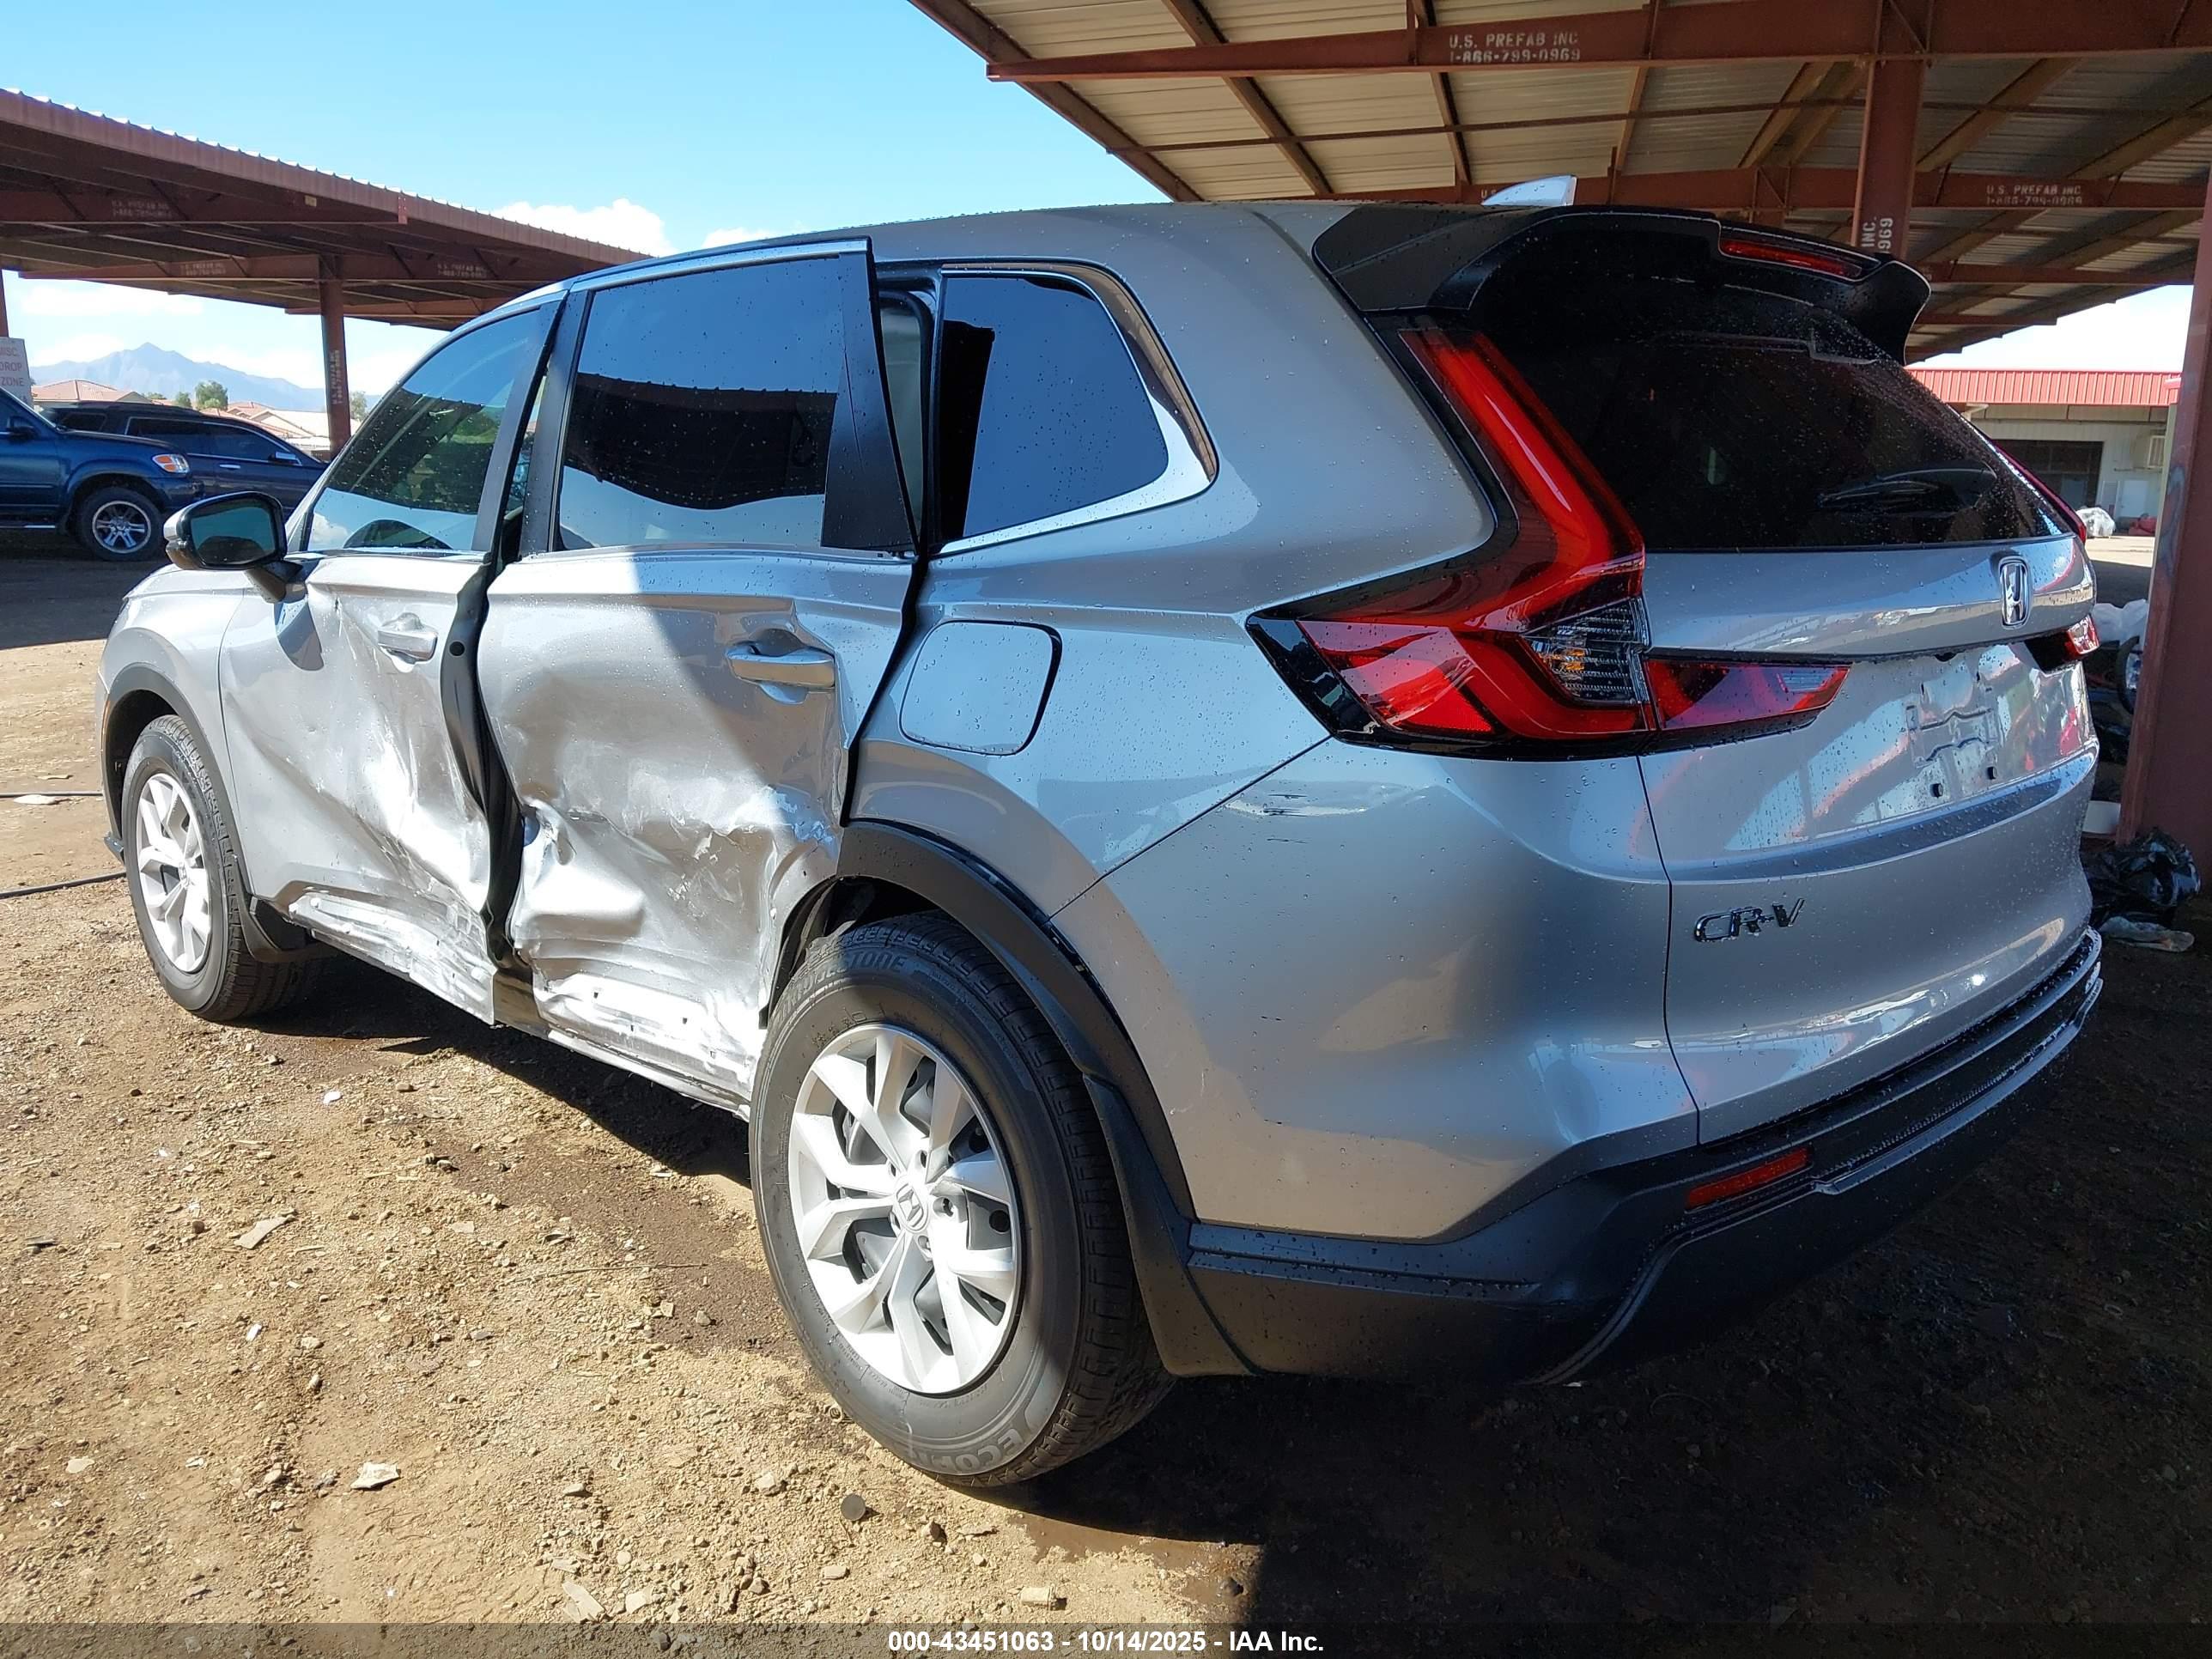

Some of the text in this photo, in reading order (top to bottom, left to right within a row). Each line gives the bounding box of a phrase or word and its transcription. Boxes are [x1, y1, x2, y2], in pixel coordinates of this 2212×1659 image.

[1449, 34, 1478, 49] U.S.
[1486, 33, 1546, 47] PREFAB
[2013, 185, 2058, 195] PREFAB
[1861, 216, 1876, 247] INC.
[1877, 217, 1893, 254] 969
[1, 378, 24, 386] ZONE
[1694, 897, 1805, 942] CR-V
